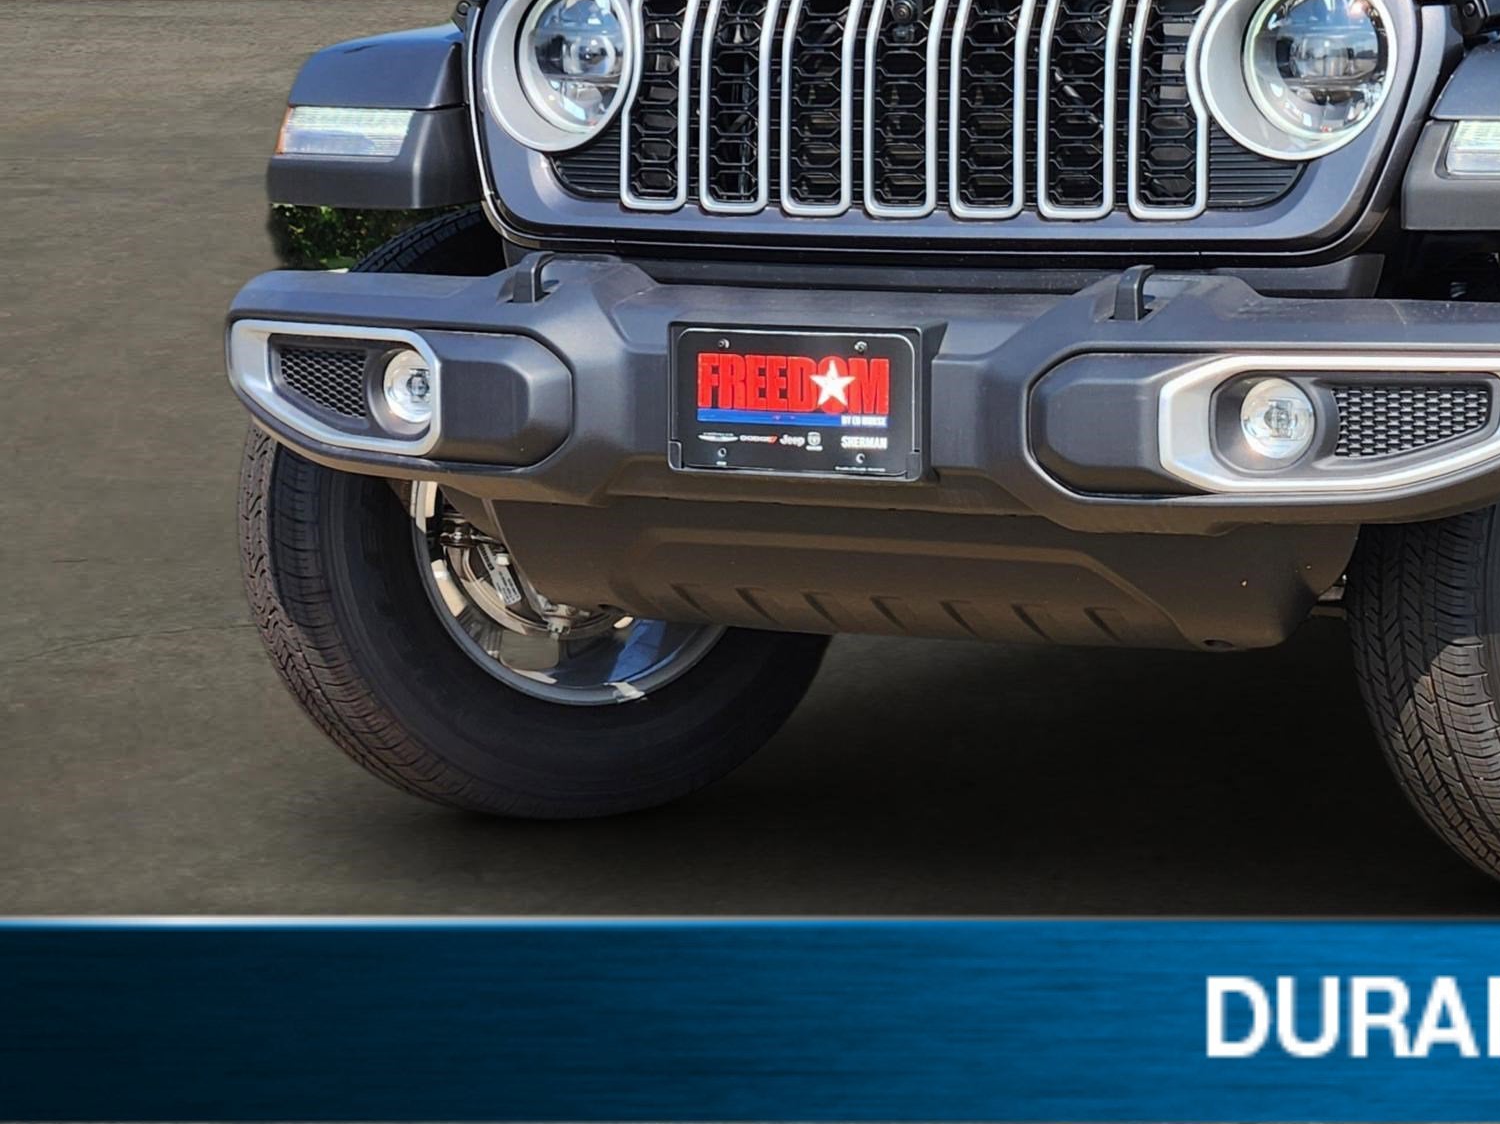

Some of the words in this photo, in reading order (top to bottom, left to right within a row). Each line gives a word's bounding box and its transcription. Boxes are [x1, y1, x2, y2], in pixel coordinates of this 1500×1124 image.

[697, 353, 890, 415] FREEDOM
[780, 434, 806, 447] Jeep
[841, 436, 888, 449] SHERMAN
